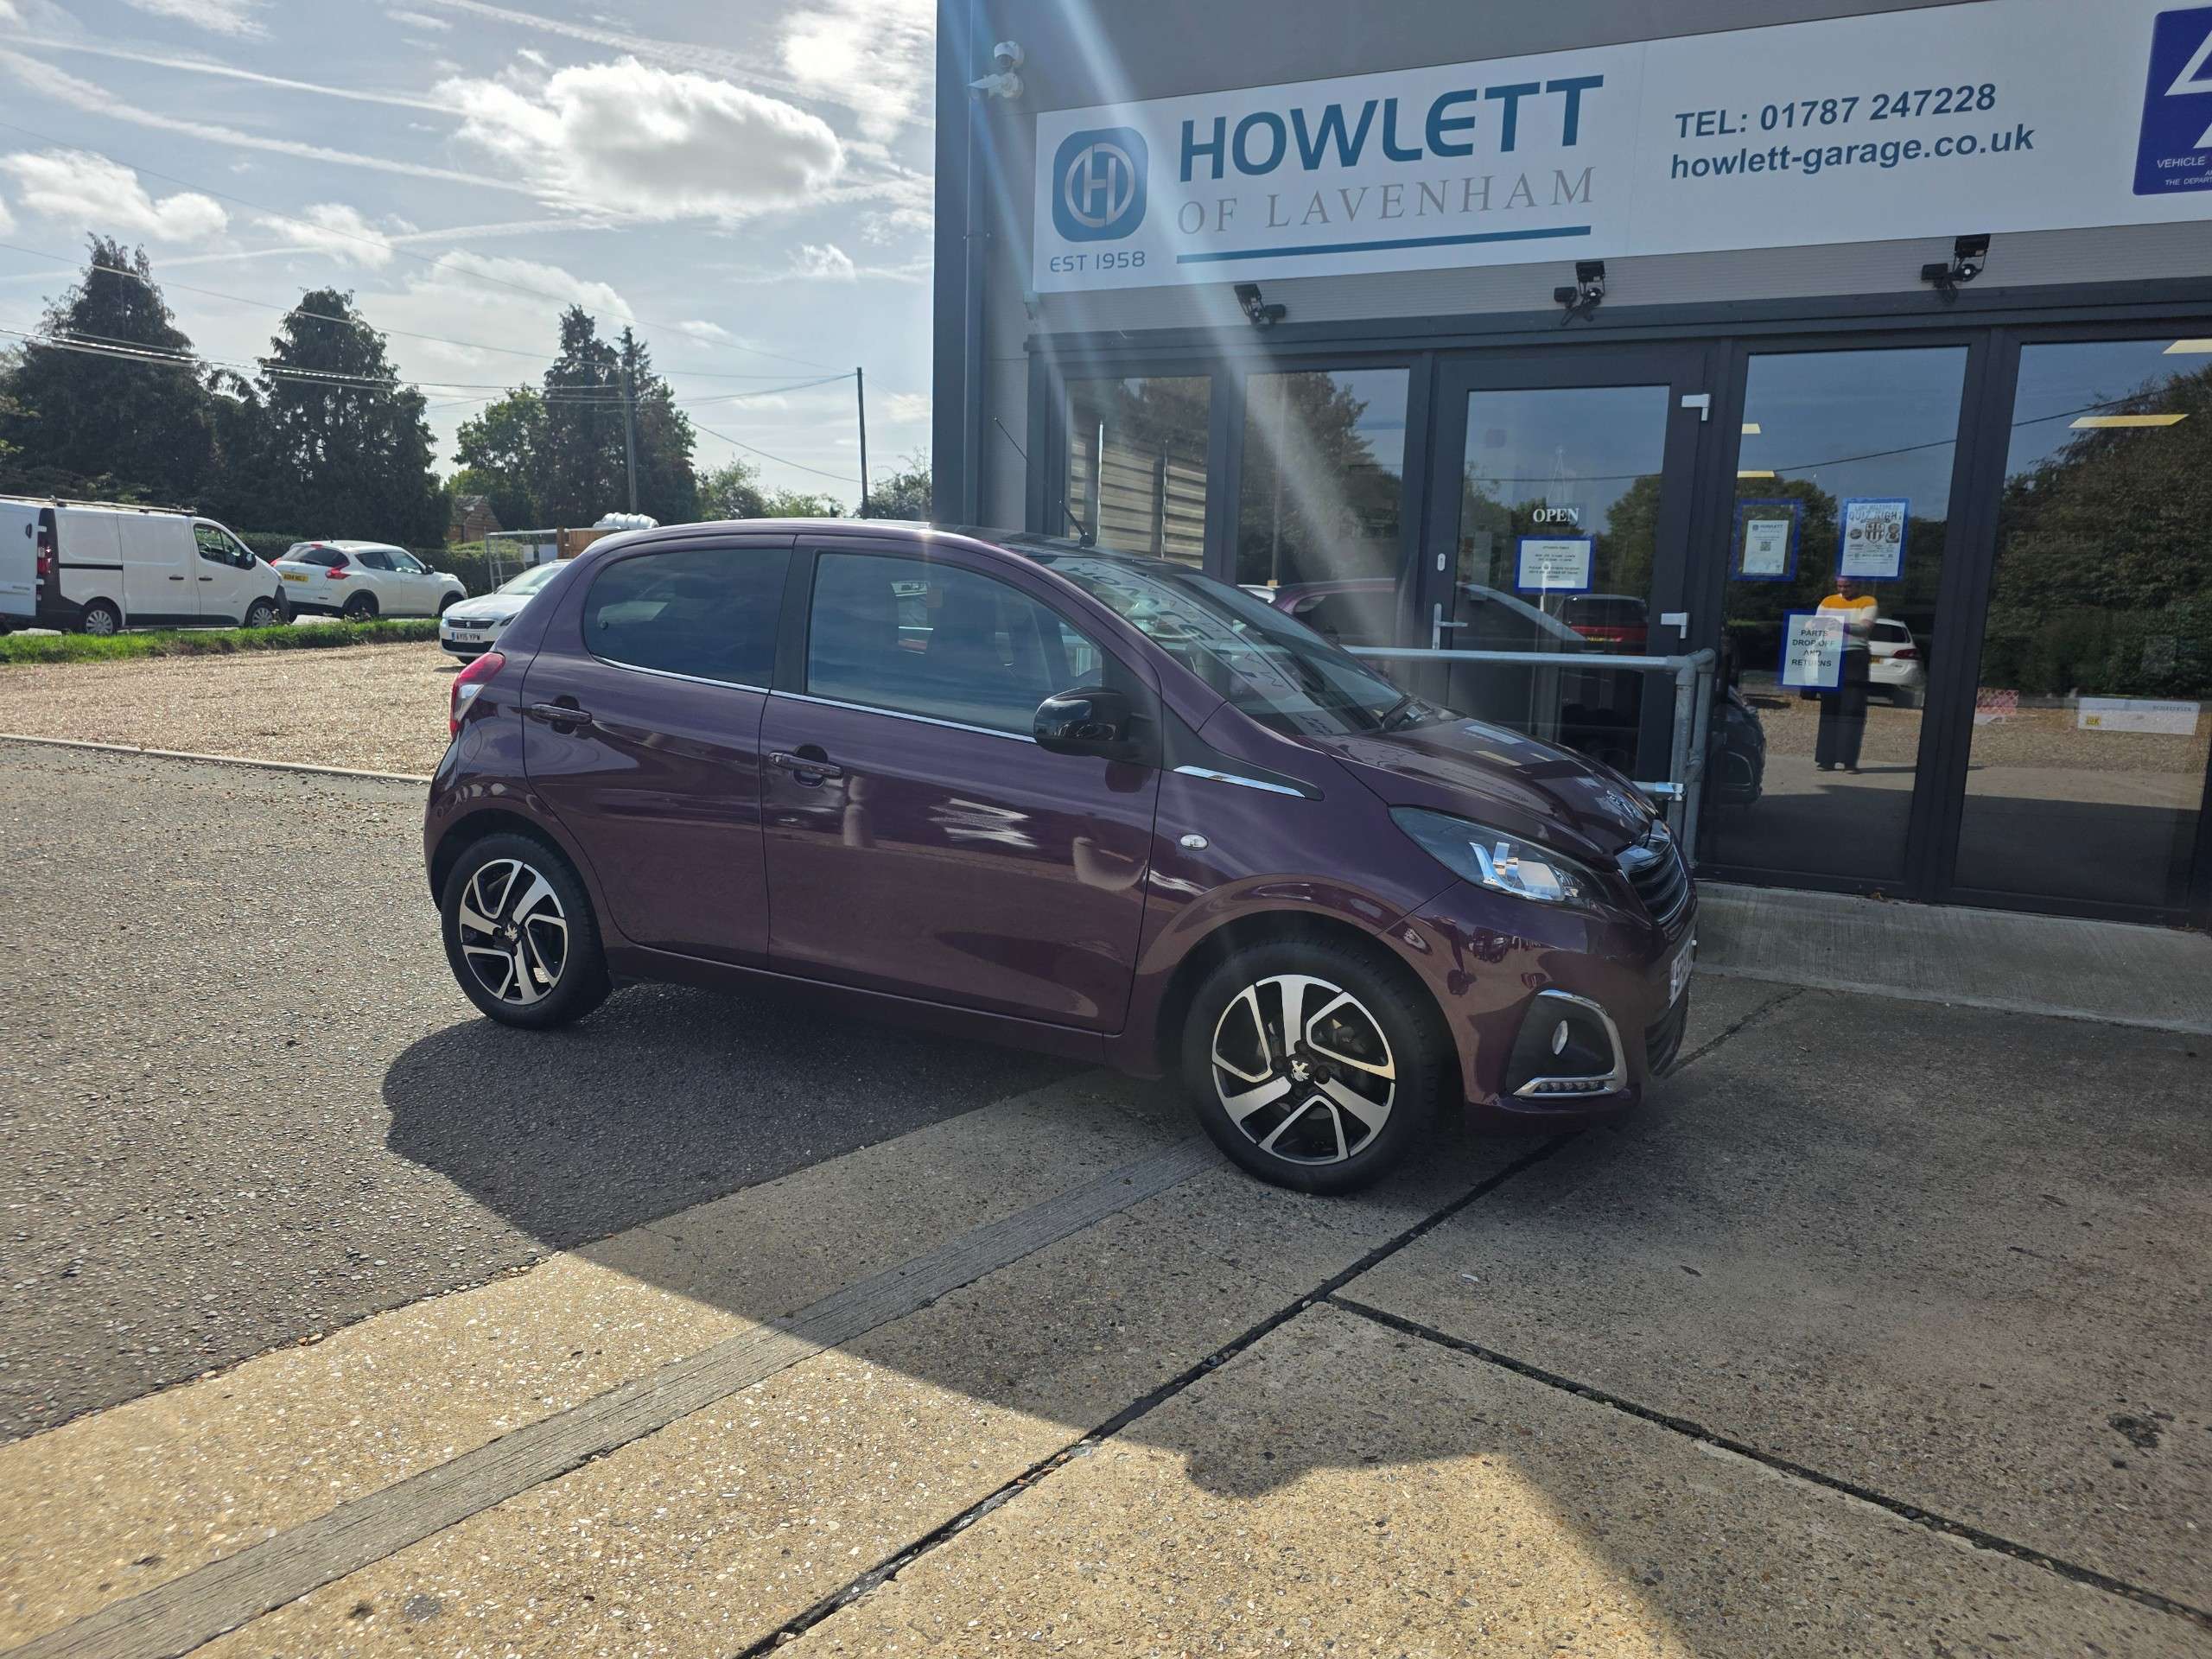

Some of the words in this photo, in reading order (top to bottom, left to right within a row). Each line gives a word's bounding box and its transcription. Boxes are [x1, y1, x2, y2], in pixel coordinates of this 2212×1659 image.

[1179, 74, 1605, 182] HOWLETT
[1675, 110, 1748, 138] TEL:
[1759, 96, 1859, 130] 01787
[1870, 83, 1997, 120] 247228
[1670, 124, 2036, 179] howlett-garage.co.uk
[2157, 156, 2206, 168] VEHICLE
[1177, 197, 1237, 235] OF
[1264, 166, 1596, 229] LAVENHAM
[1050, 255, 1088, 273] EST
[1096, 251, 1146, 270] 1958
[1533, 507, 1580, 523] OPEN
[1792, 639, 1817, 647] DROP
